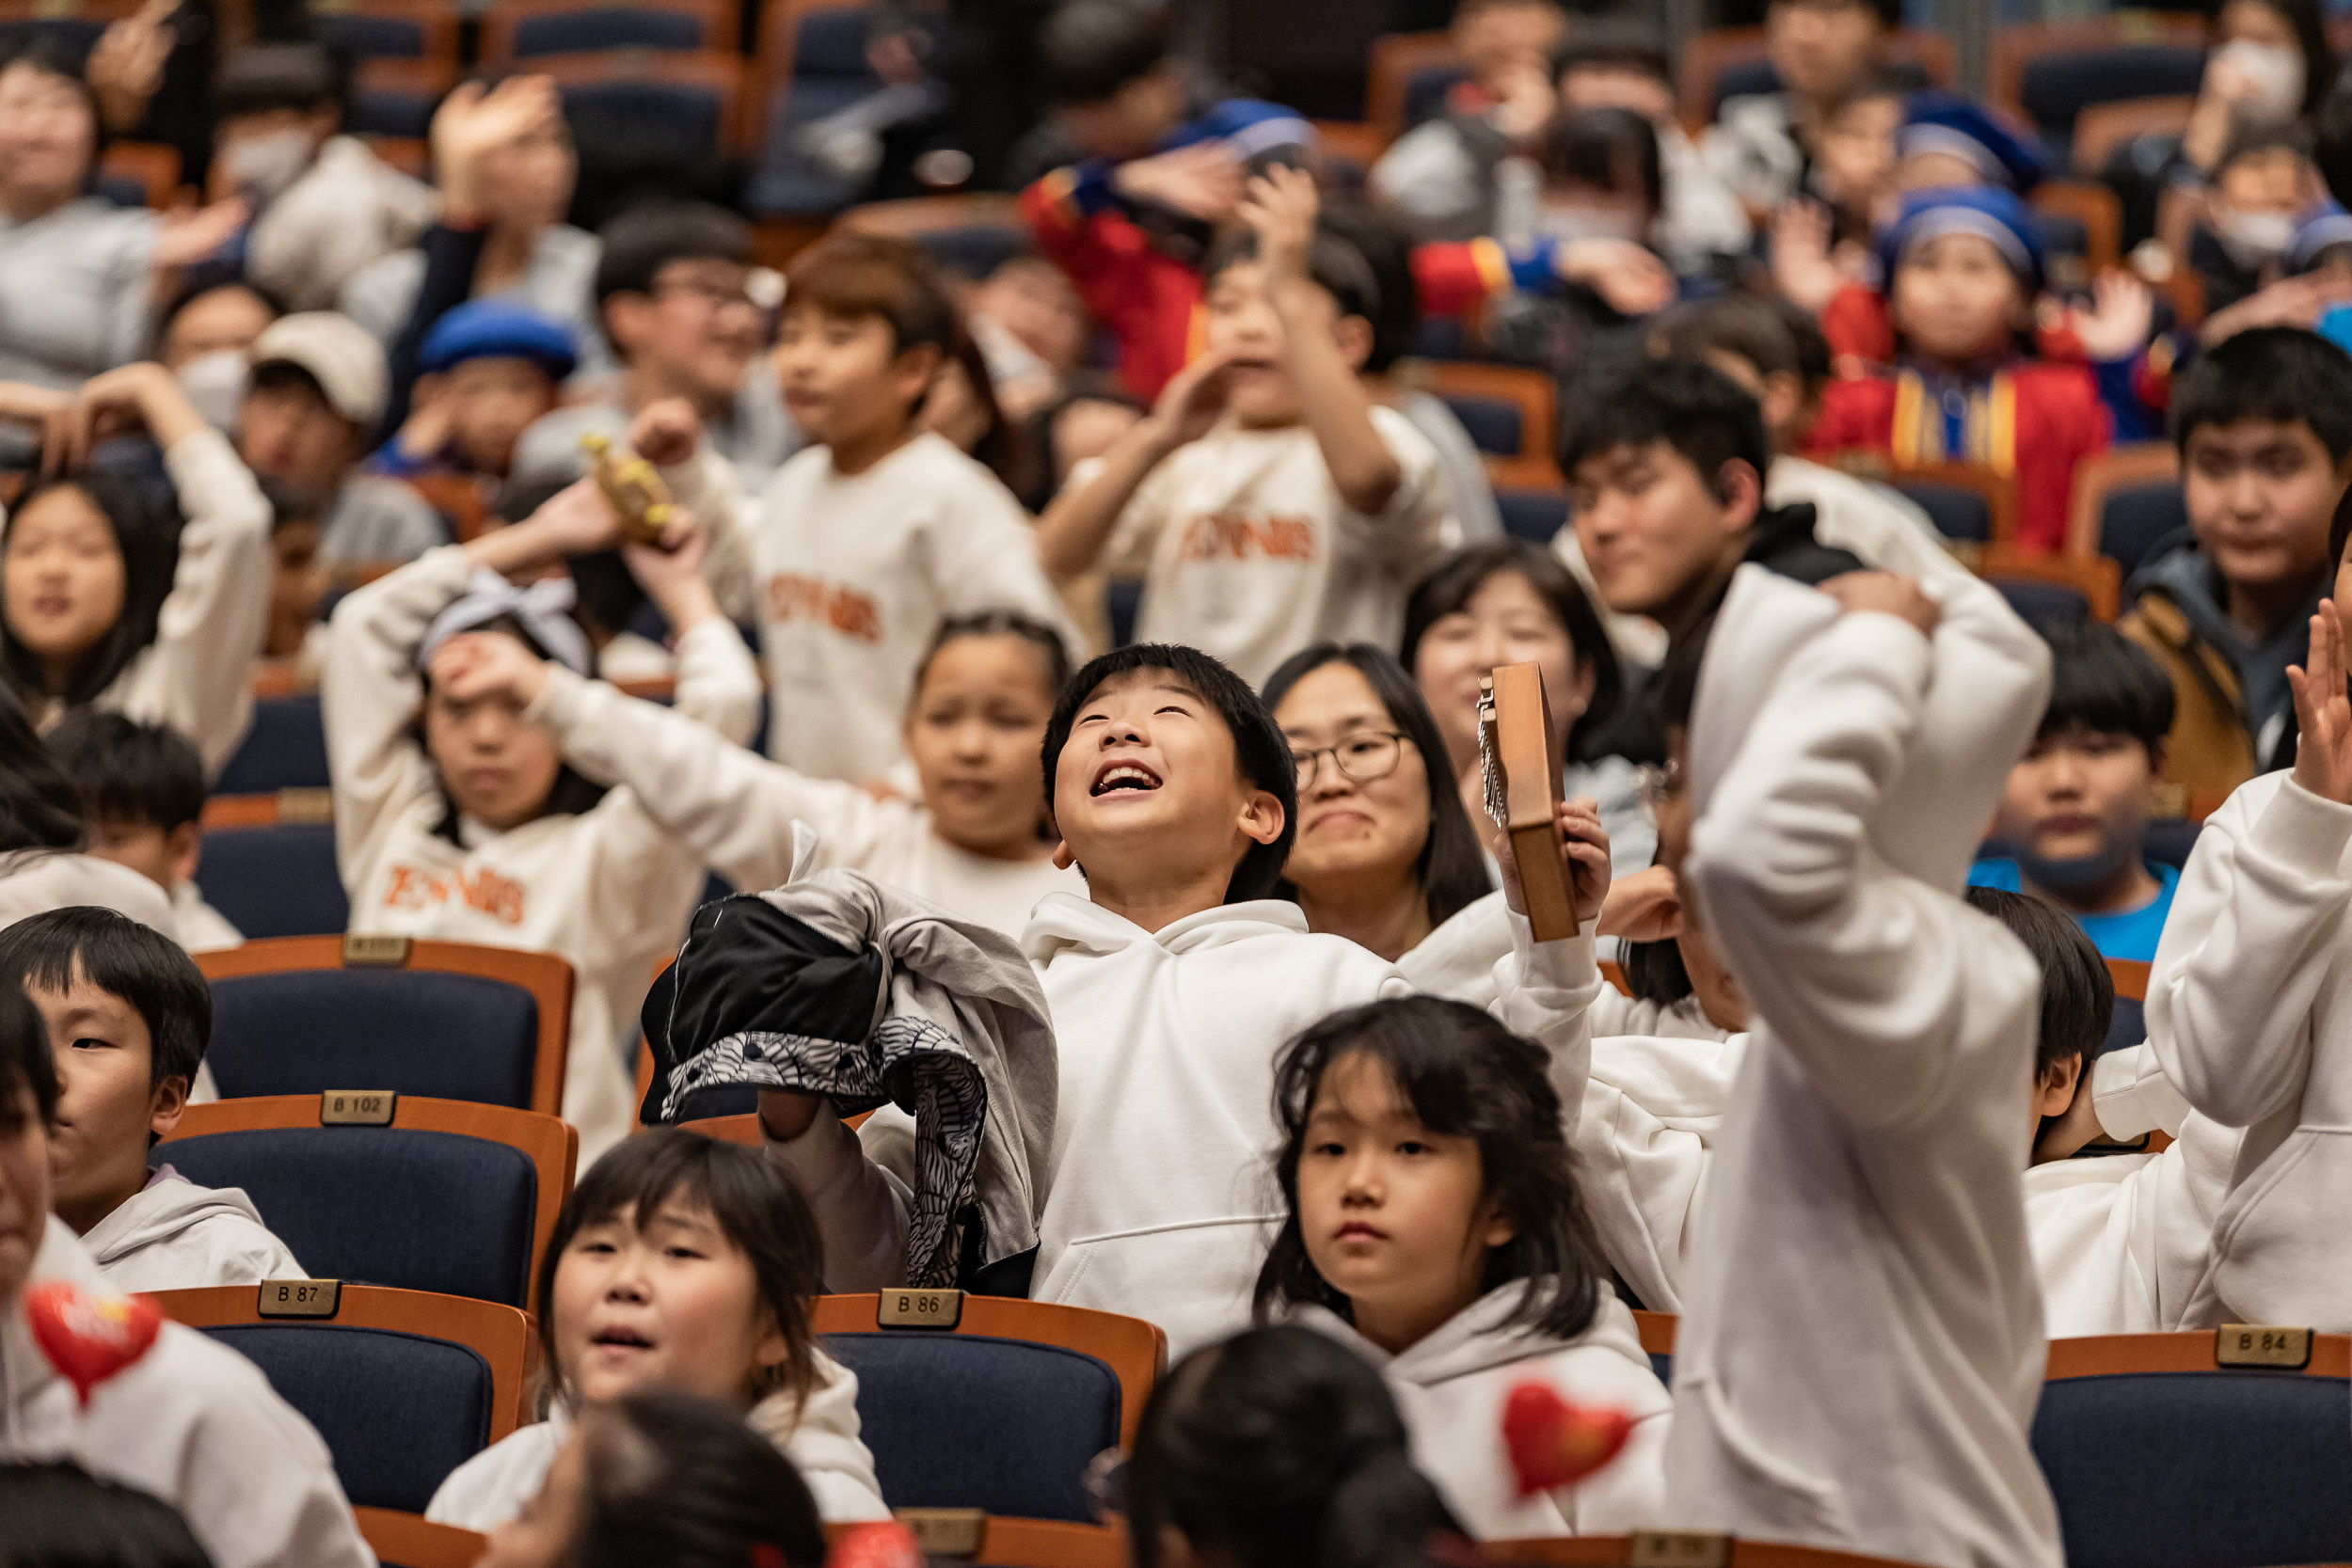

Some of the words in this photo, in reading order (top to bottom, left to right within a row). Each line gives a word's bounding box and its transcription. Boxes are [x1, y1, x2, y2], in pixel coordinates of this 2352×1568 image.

[353, 1097, 381, 1113] 102
[278, 1287, 289, 1302] B
[296, 1287, 318, 1303] 87
[898, 1296, 910, 1312] B
[918, 1296, 940, 1312] 86
[2240, 1334, 2251, 1351] B
[2262, 1334, 2285, 1351] 84
